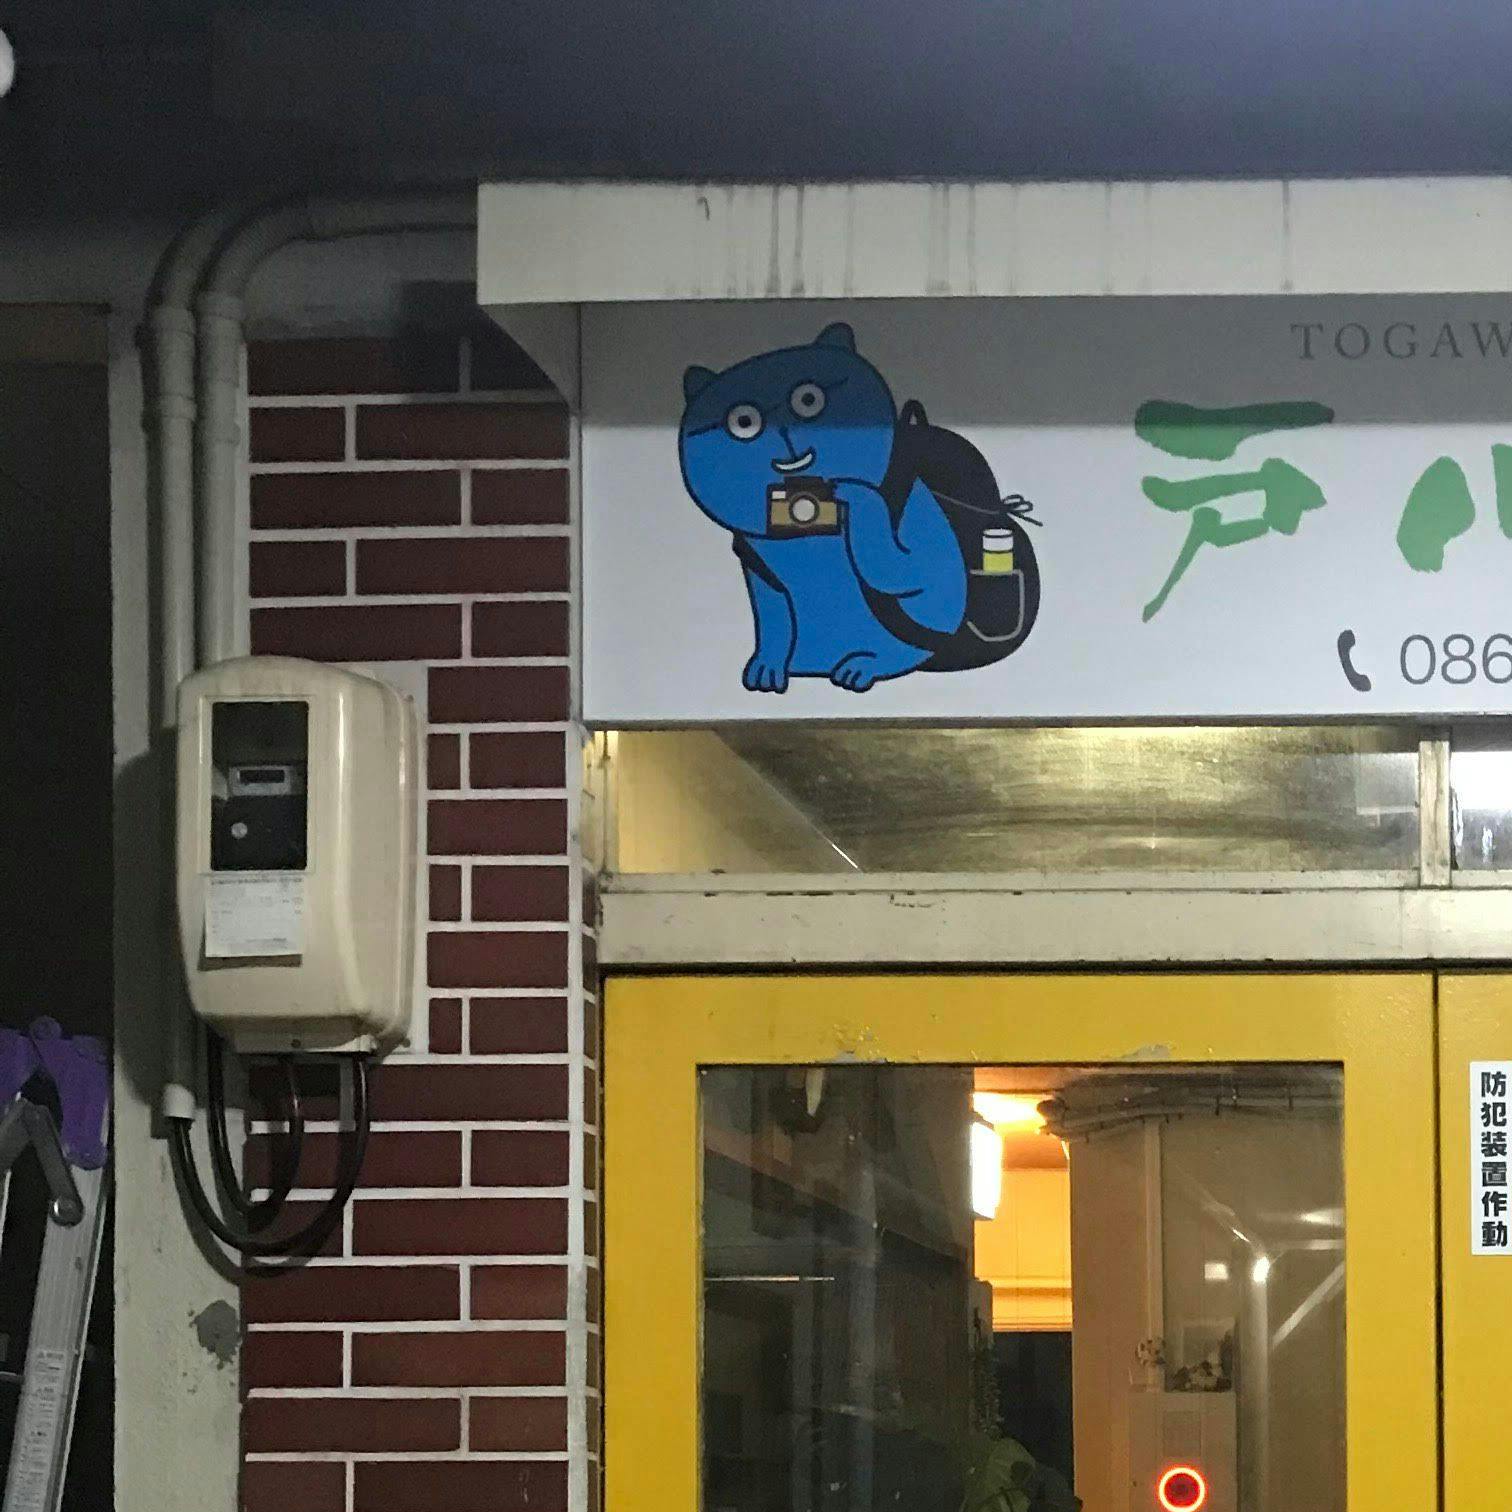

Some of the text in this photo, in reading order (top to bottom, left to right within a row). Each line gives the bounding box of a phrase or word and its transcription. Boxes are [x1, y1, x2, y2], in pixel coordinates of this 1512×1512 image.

[1481, 1070, 1508, 1248] 防犯装置作動
